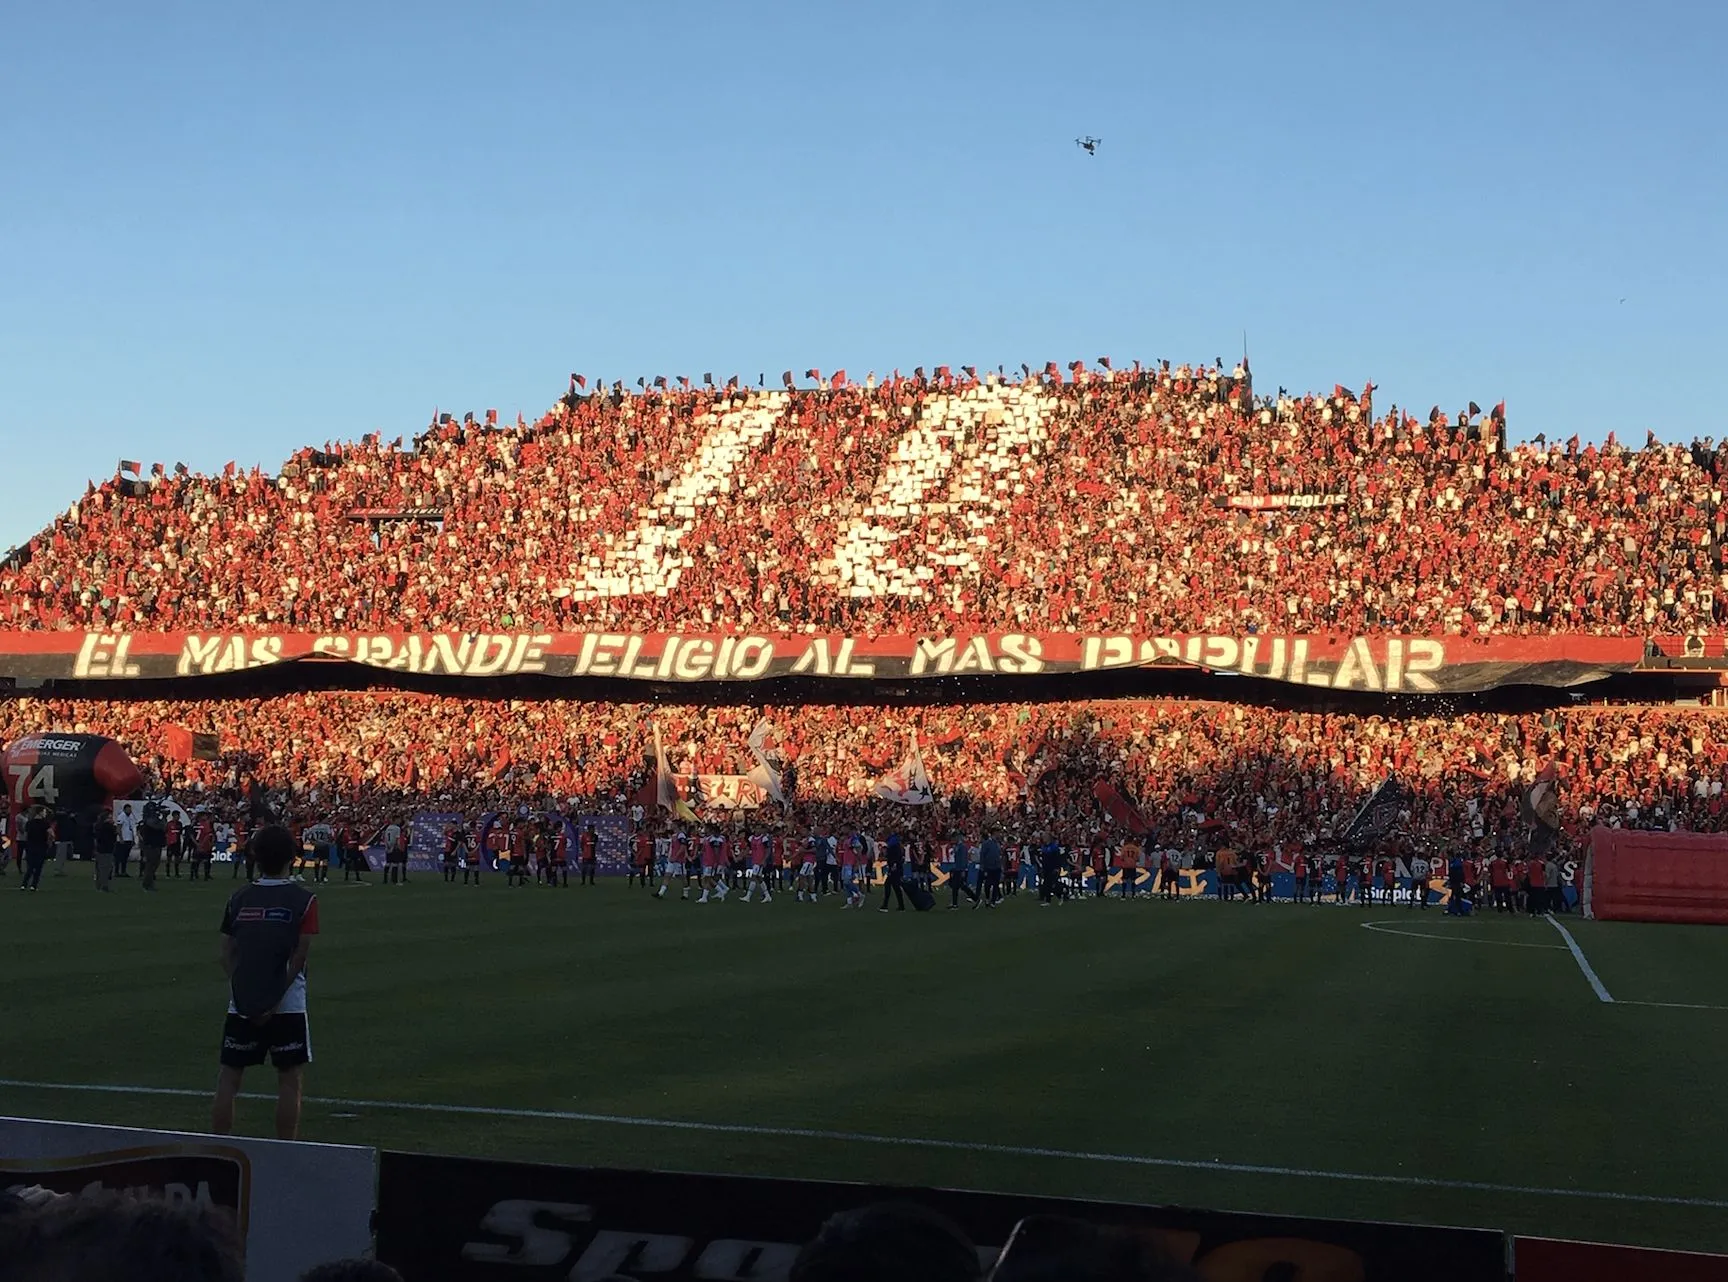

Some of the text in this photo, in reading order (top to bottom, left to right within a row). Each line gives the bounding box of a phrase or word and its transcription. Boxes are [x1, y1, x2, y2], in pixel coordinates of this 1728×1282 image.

[1231, 494, 1348, 508] SAN NICOLAS
[73, 633, 139, 676] EL
[178, 635, 282, 675] MAS
[574, 632, 774, 677] ELIGIO
[790, 637, 875, 675] AL
[910, 634, 1043, 674] MAS
[8, 764, 60, 804] 74
